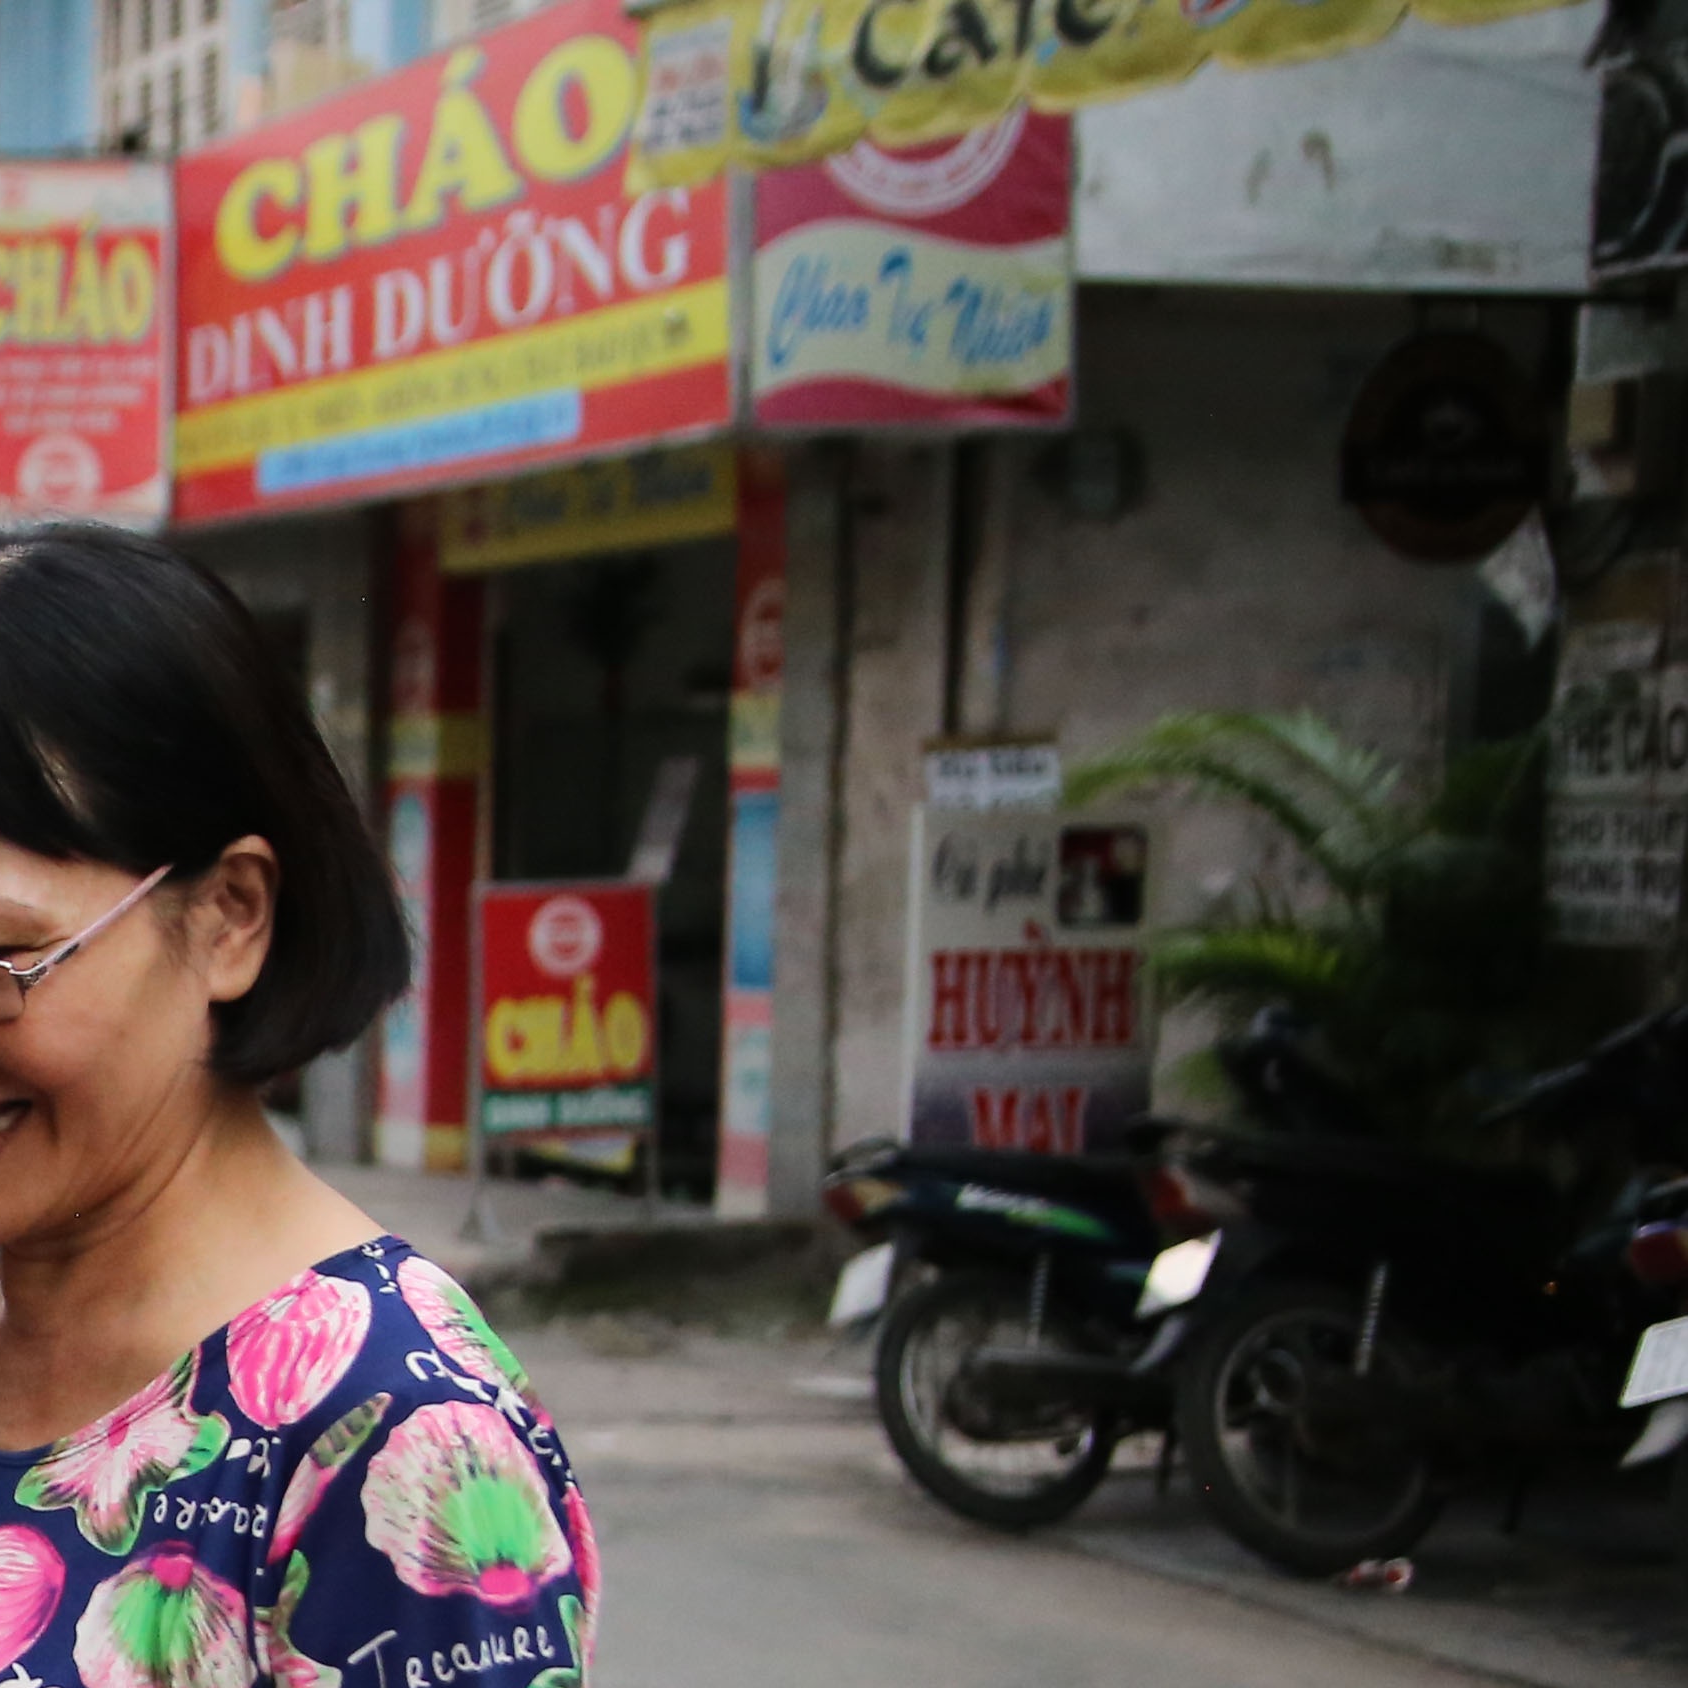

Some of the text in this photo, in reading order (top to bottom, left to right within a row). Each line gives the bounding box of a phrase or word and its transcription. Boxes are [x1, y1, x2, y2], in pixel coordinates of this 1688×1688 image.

[216, 35, 639, 280] CHÁO
[188, 283, 354, 404] DINH
[486, 974, 645, 1078] CHÁO
